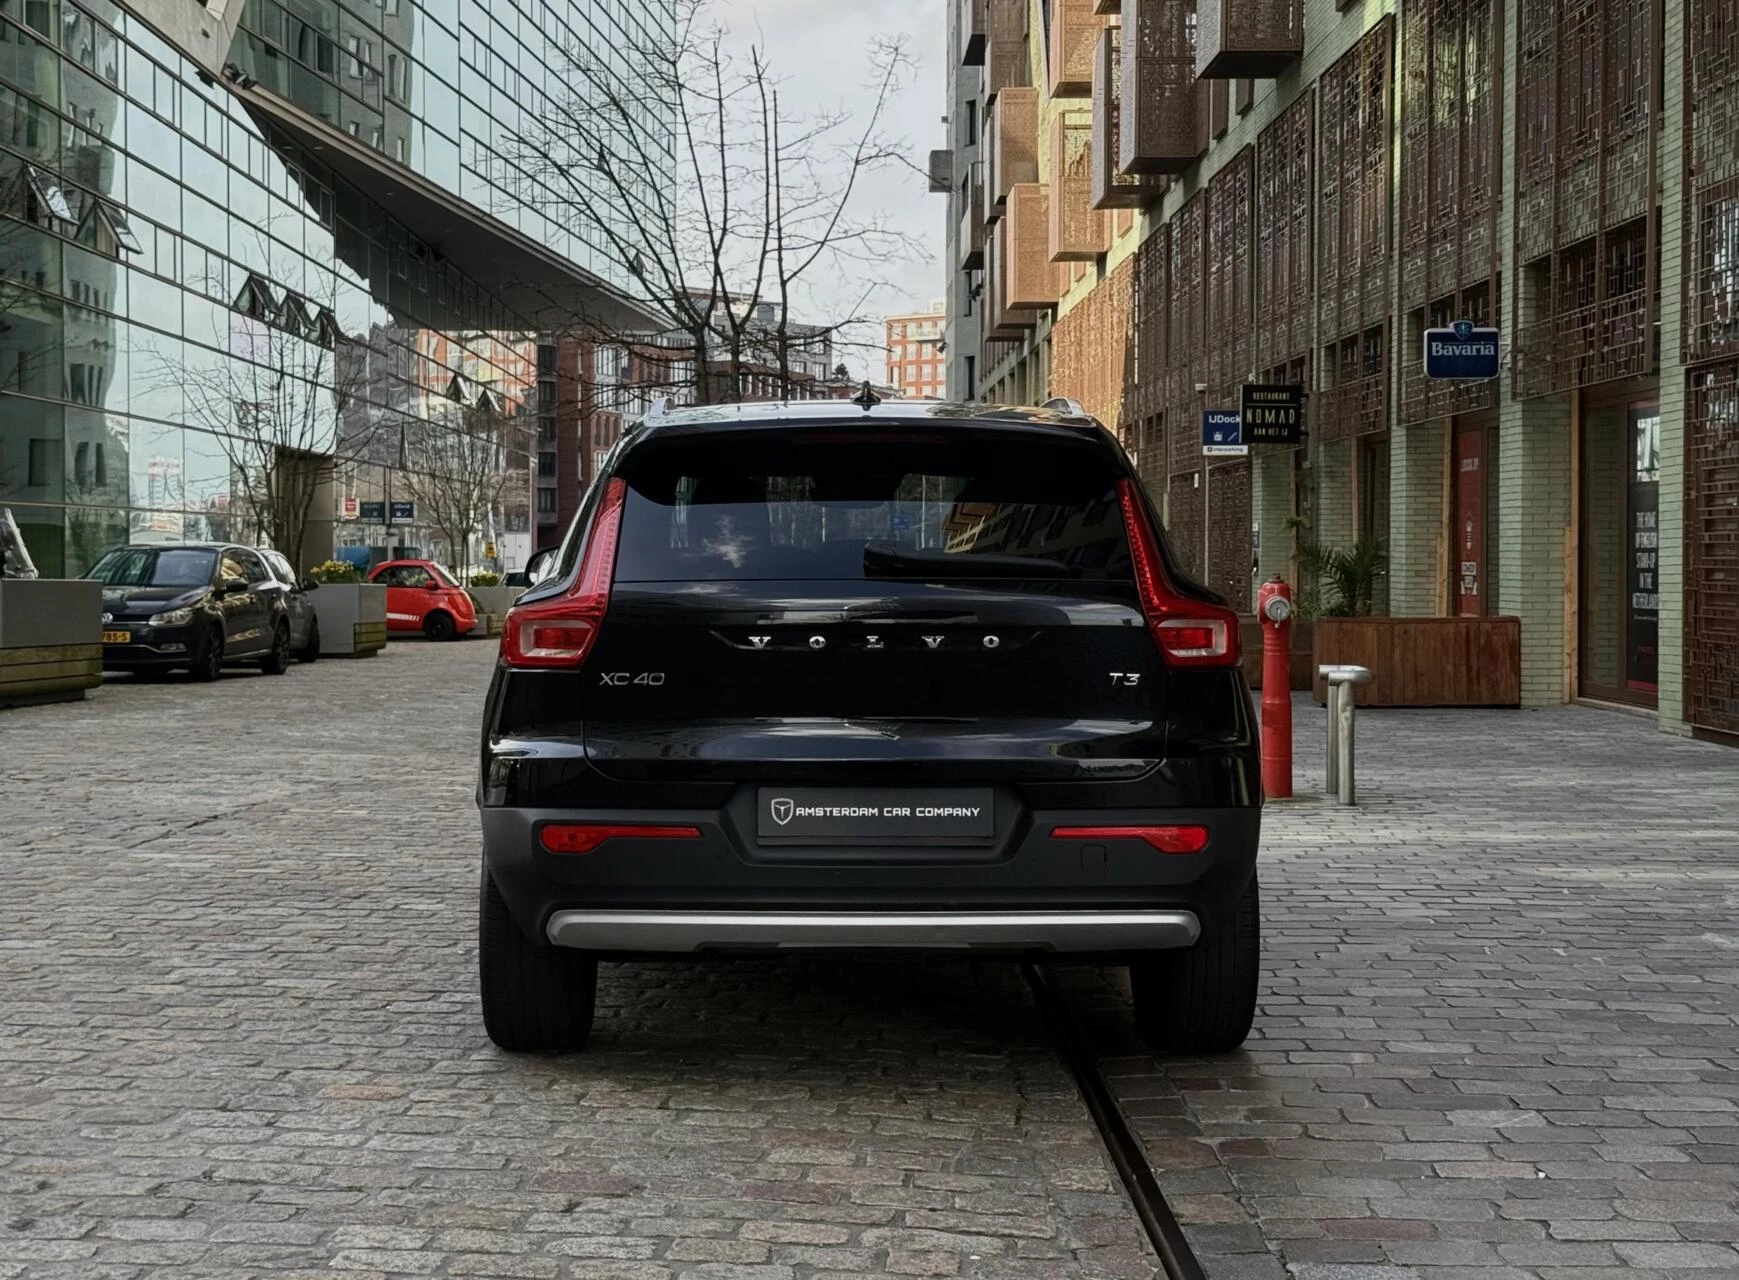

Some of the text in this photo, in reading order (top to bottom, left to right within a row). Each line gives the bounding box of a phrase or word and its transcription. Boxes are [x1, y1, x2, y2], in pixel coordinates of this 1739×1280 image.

[1431, 341, 1495, 356] Bavaria
[1253, 392, 1290, 400] RESTAURANT
[1246, 408, 1295, 424] NOMAD
[748, 635, 1000, 649] VOLVO
[1109, 672, 1141, 686] T3
[795, 807, 981, 817] AMSTERDAM CAR COMPANY
